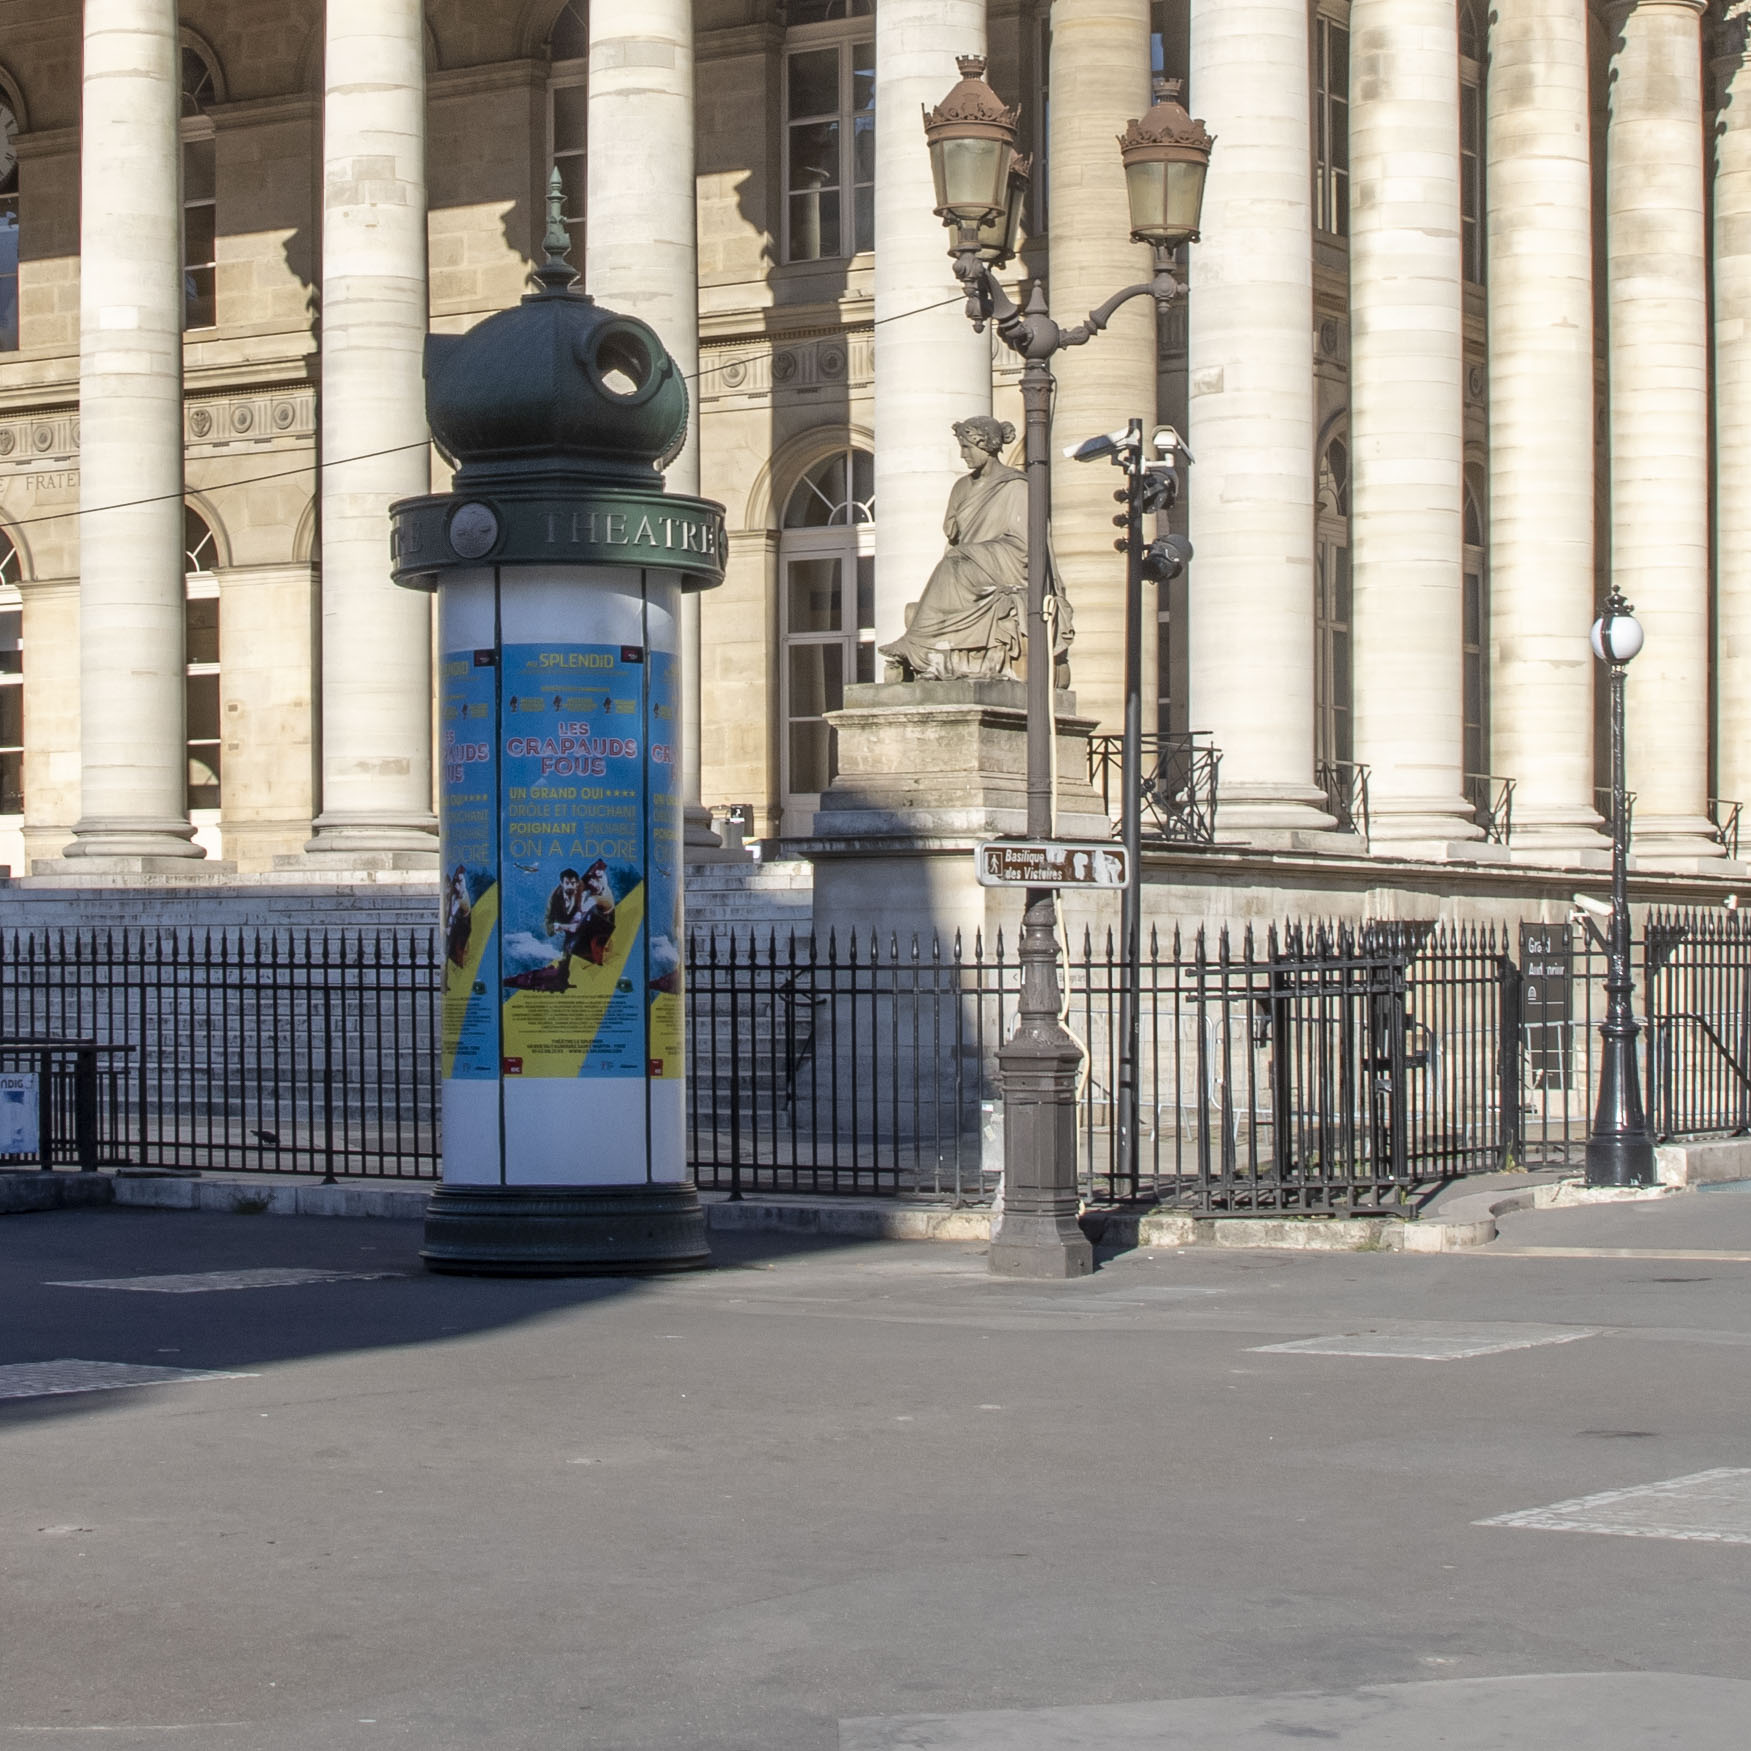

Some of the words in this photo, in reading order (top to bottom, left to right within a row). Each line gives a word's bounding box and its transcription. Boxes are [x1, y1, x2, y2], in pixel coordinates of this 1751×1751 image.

[559, 721, 590, 737] LES
[507, 737, 638, 759] CRAPAUDS
[540, 756, 606, 777] FOUS
[509, 787, 526, 799] UN
[530, 787, 577, 799] GRAND
[509, 822, 577, 834] POIGNANT
[509, 839, 543, 859] ON
[549, 839, 564, 858] A
[1004, 848, 1045, 866] Basilique
[1005, 867, 1021, 880] des
[1528, 936, 1551, 954] Grad
